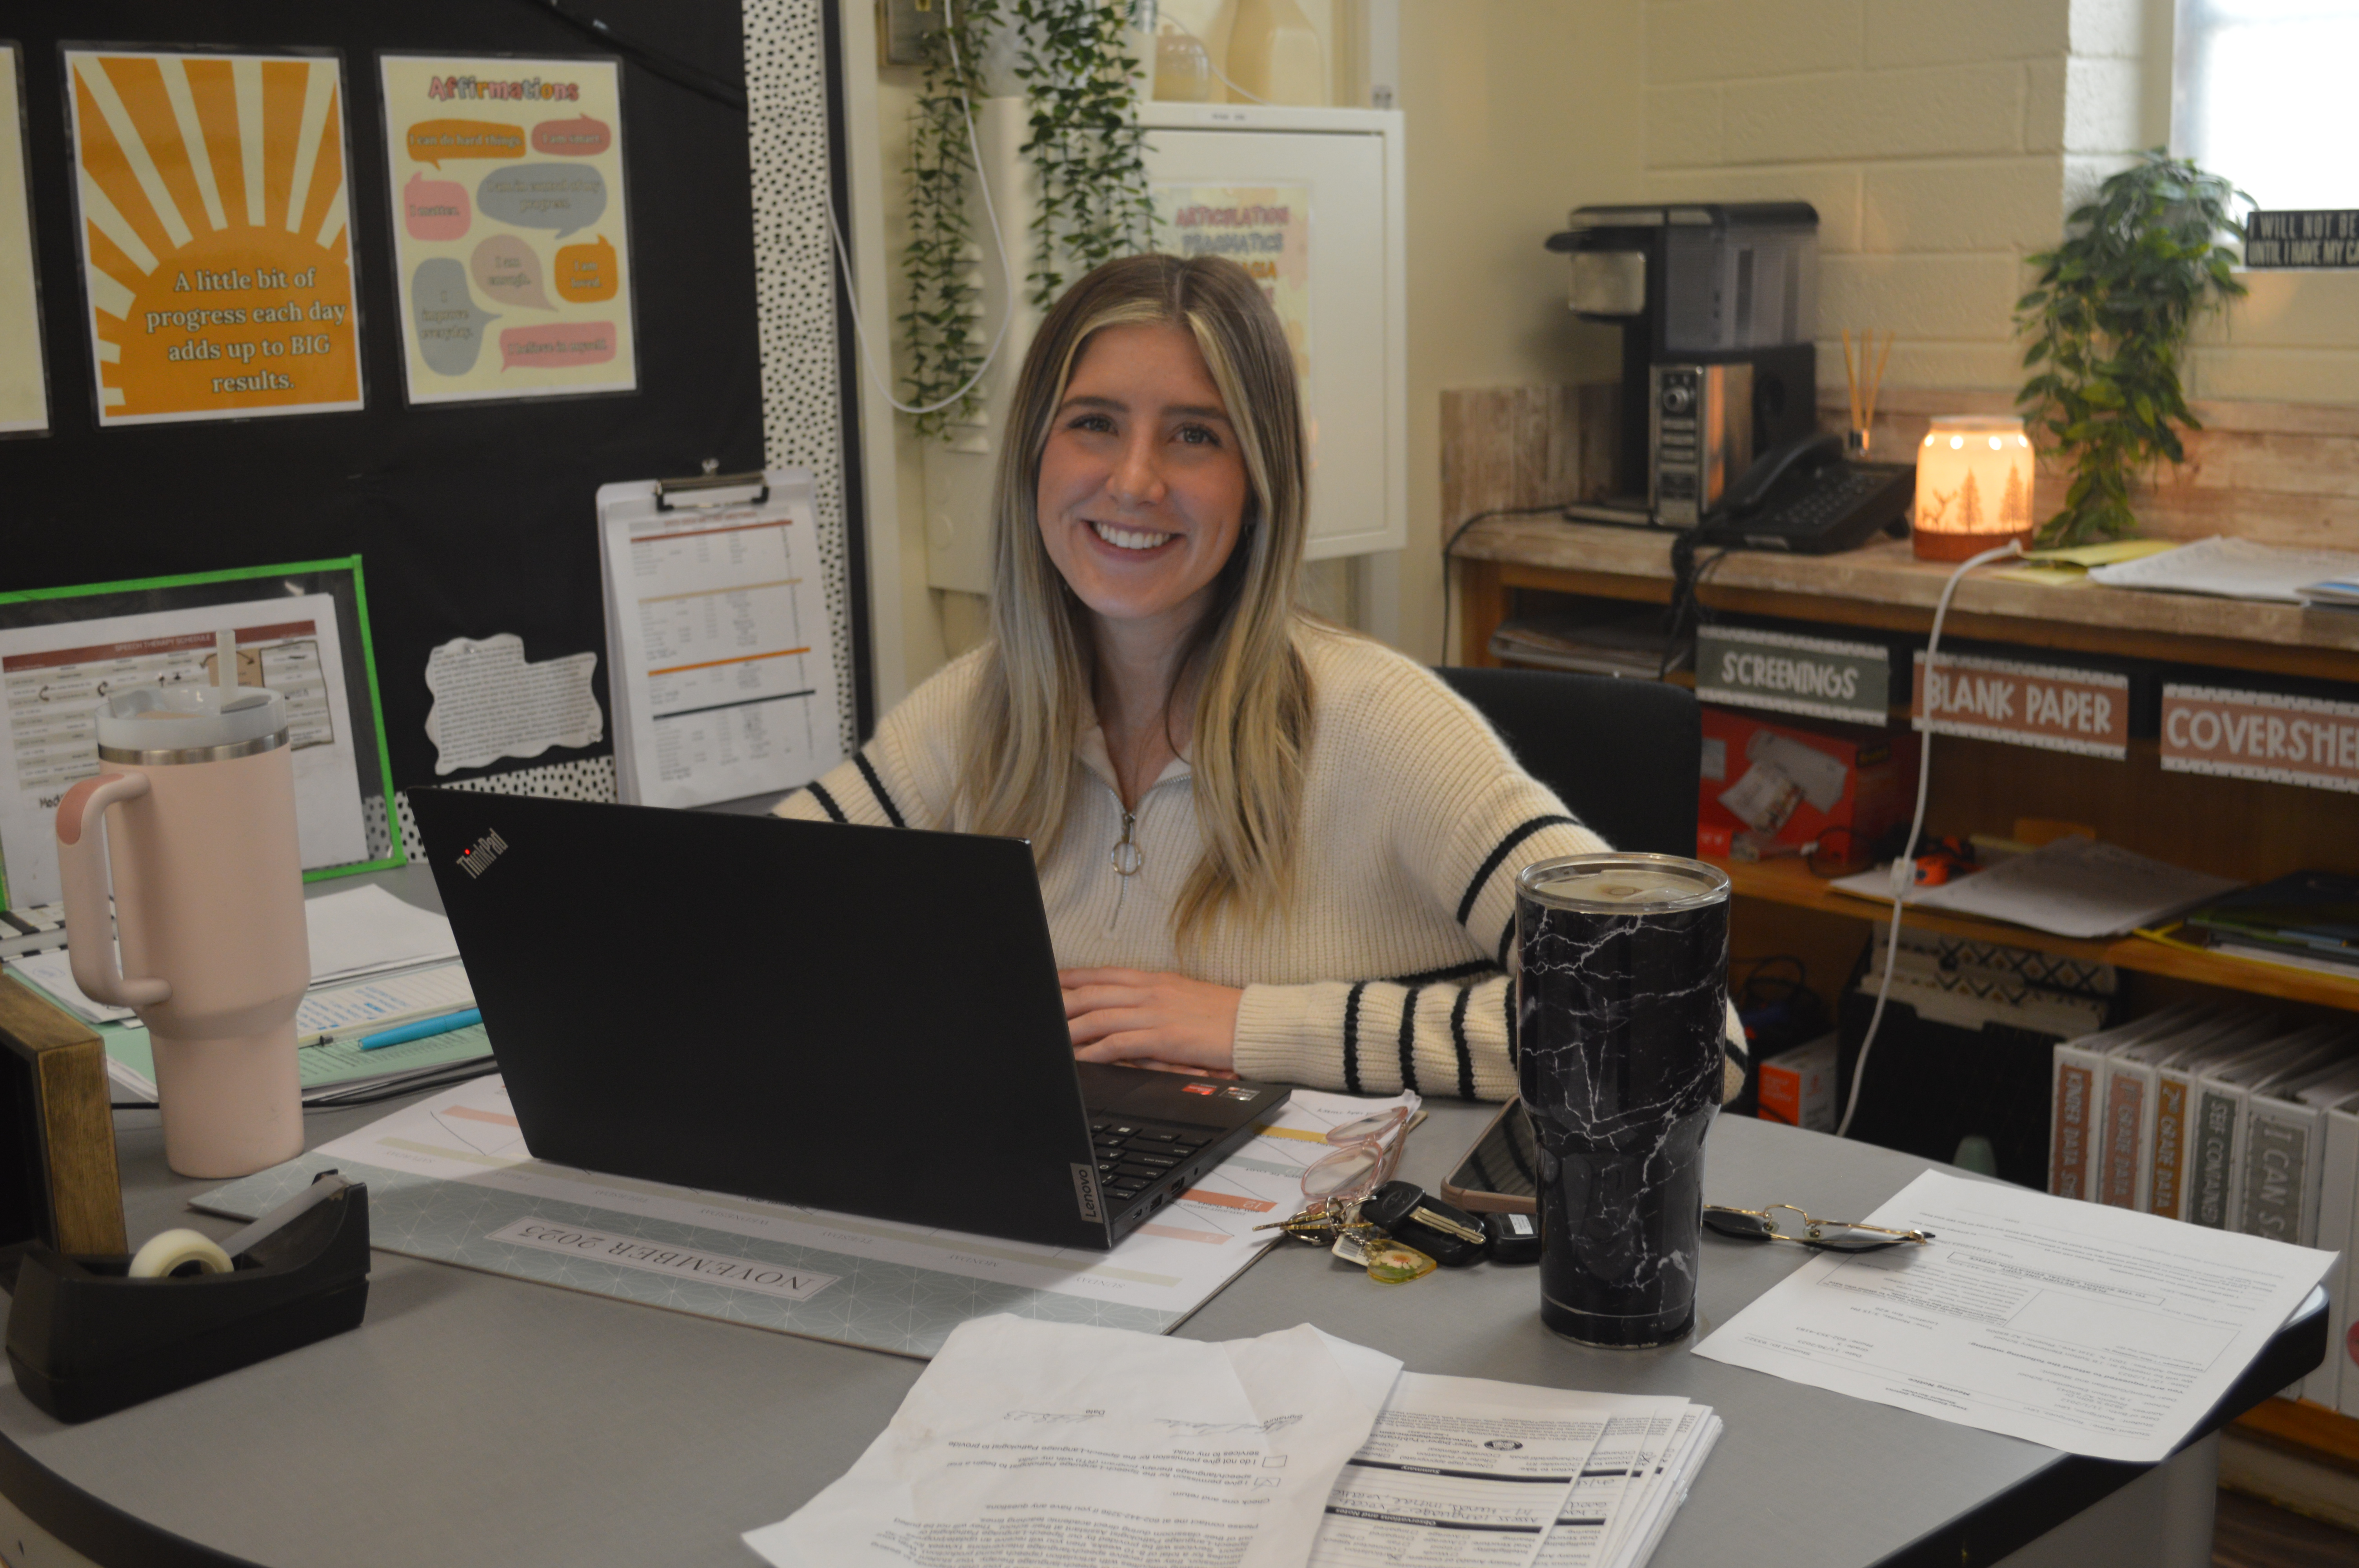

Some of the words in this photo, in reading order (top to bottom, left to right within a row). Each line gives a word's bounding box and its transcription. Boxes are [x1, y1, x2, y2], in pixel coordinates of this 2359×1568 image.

[428, 75, 580, 101] Affirmations
[1176, 206, 1289, 228] ARTICULATION
[2248, 213, 2254, 238] I
[2260, 213, 2295, 238] WILL
[2303, 212, 2332, 238] NOT
[2339, 212, 2356, 238] BE
[1182, 233, 1283, 256] PRAGMATICS
[174, 271, 191, 292] A
[196, 269, 252, 291] little
[256, 267, 289, 289] bit
[294, 266, 316, 288] of
[145, 308, 247, 334] progress
[252, 301, 304, 323] each
[309, 300, 347, 326] day
[168, 339, 222, 361] adds
[226, 342, 255, 363] up
[261, 339, 285, 356] to
[290, 334, 331, 355] BIG
[211, 369, 295, 393] results.
[1721, 650, 1859, 700] SCREENINGS
[1927, 672, 2014, 721] BLANK
[2025, 683, 2112, 733] PAPER
[2166, 706, 2359, 769] COVERSHE
[456, 827, 509, 879] ThinkPad
[2064, 1073, 2083, 1124] KINDER
[2114, 1104, 2134, 1154] GRADE
[2062, 1127, 2081, 1166] DATA
[2157, 1118, 2177, 1167] GRADE
[2113, 1156, 2132, 1196] DATA
[2155, 1169, 2174, 1208] DATA
[2259, 1149, 2290, 1206] CAN
[1079, 1169, 1097, 1218] Lenovo
[606, 1242, 815, 1291] NOVEMBER
[1076, 1277, 1125, 1289] SUNDAY
[2006, 1351, 2045, 1363] following
[2063, 1366, 2091, 1374] attend
[1908, 1378, 1934, 1387] Notice
[1937, 1385, 1970, 1396] Meeting
[2104, 1376, 2148, 1387] requested
[1009, 1461, 1056, 1470] Pathologist
[1152, 1454, 1201, 1463] permission
[1401, 1465, 1440, 1474] Summary
[1173, 1474, 1222, 1485] permission
[1335, 1508, 1360, 1517] Notes
[1380, 1515, 1436, 1526] Observations
